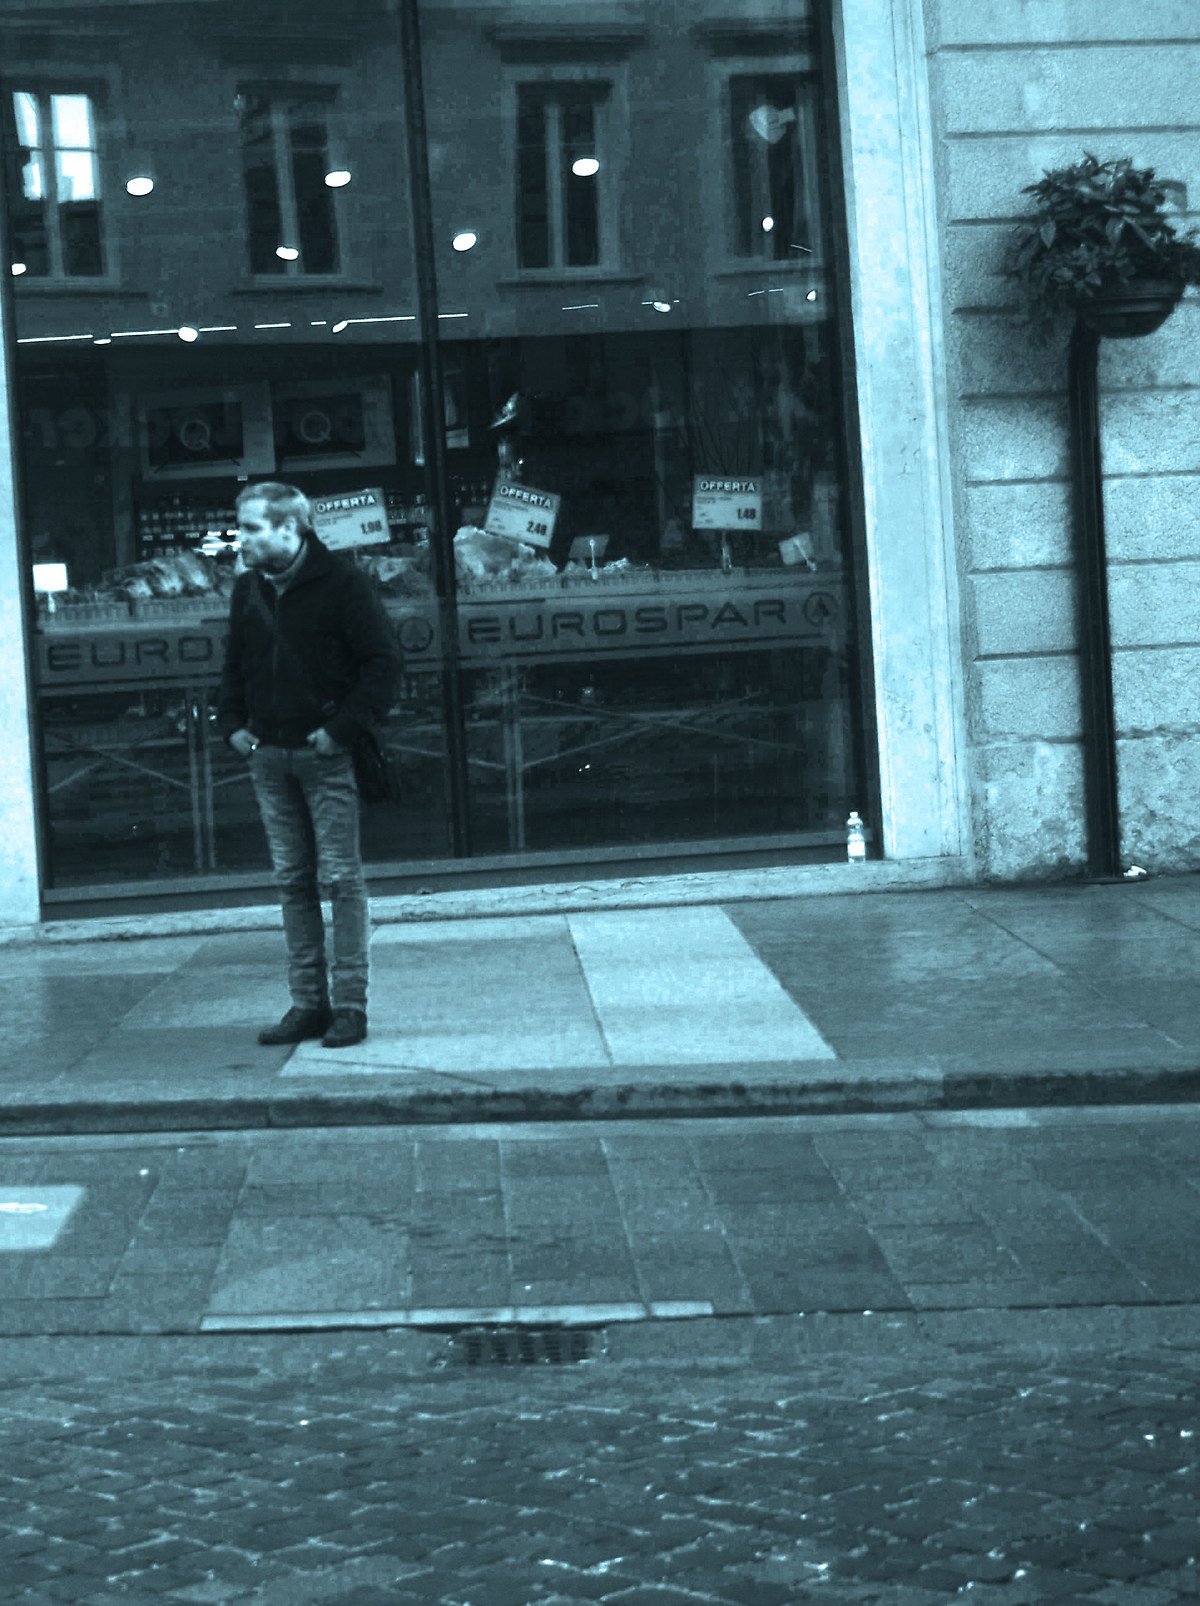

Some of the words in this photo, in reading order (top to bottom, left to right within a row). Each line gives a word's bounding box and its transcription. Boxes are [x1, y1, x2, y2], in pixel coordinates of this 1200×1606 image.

[499, 485, 552, 509] OFFERTA
[699, 480, 756, 493] OFFERTA
[316, 494, 376, 513] OFFERTA
[467, 599, 788, 643] EUROSPAR
[48, 635, 227, 671] EURO
